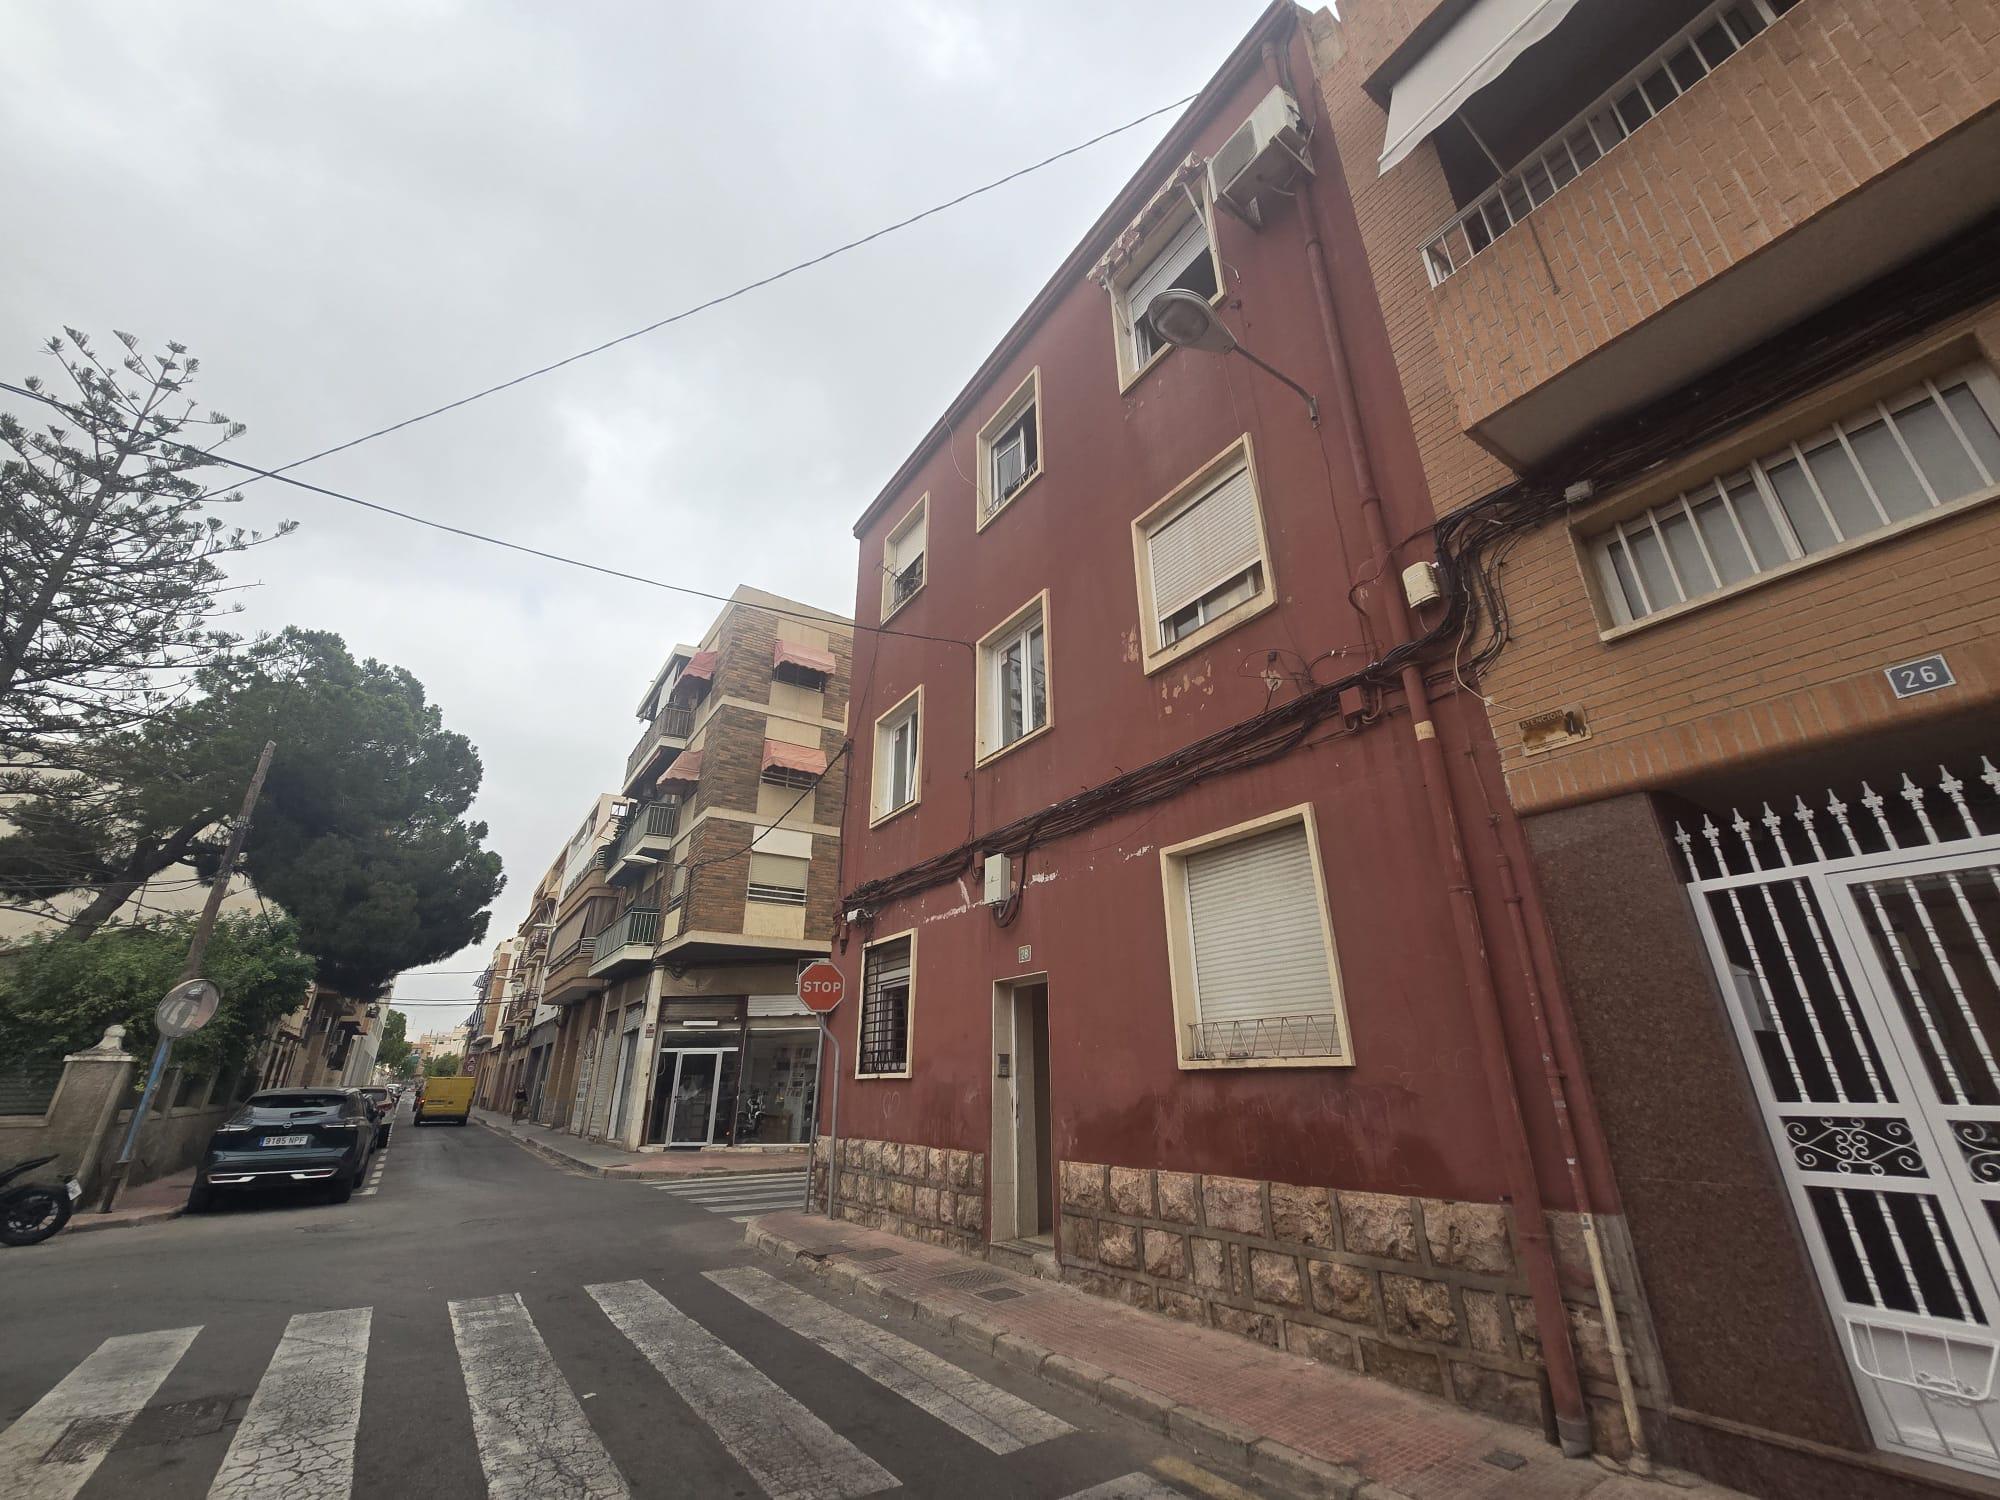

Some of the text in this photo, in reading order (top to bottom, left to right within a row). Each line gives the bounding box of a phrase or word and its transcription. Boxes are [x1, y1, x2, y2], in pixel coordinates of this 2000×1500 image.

[1900, 665, 1937, 689] 26
[1020, 948, 1029, 960] 28
[803, 981, 841, 993] STOP
